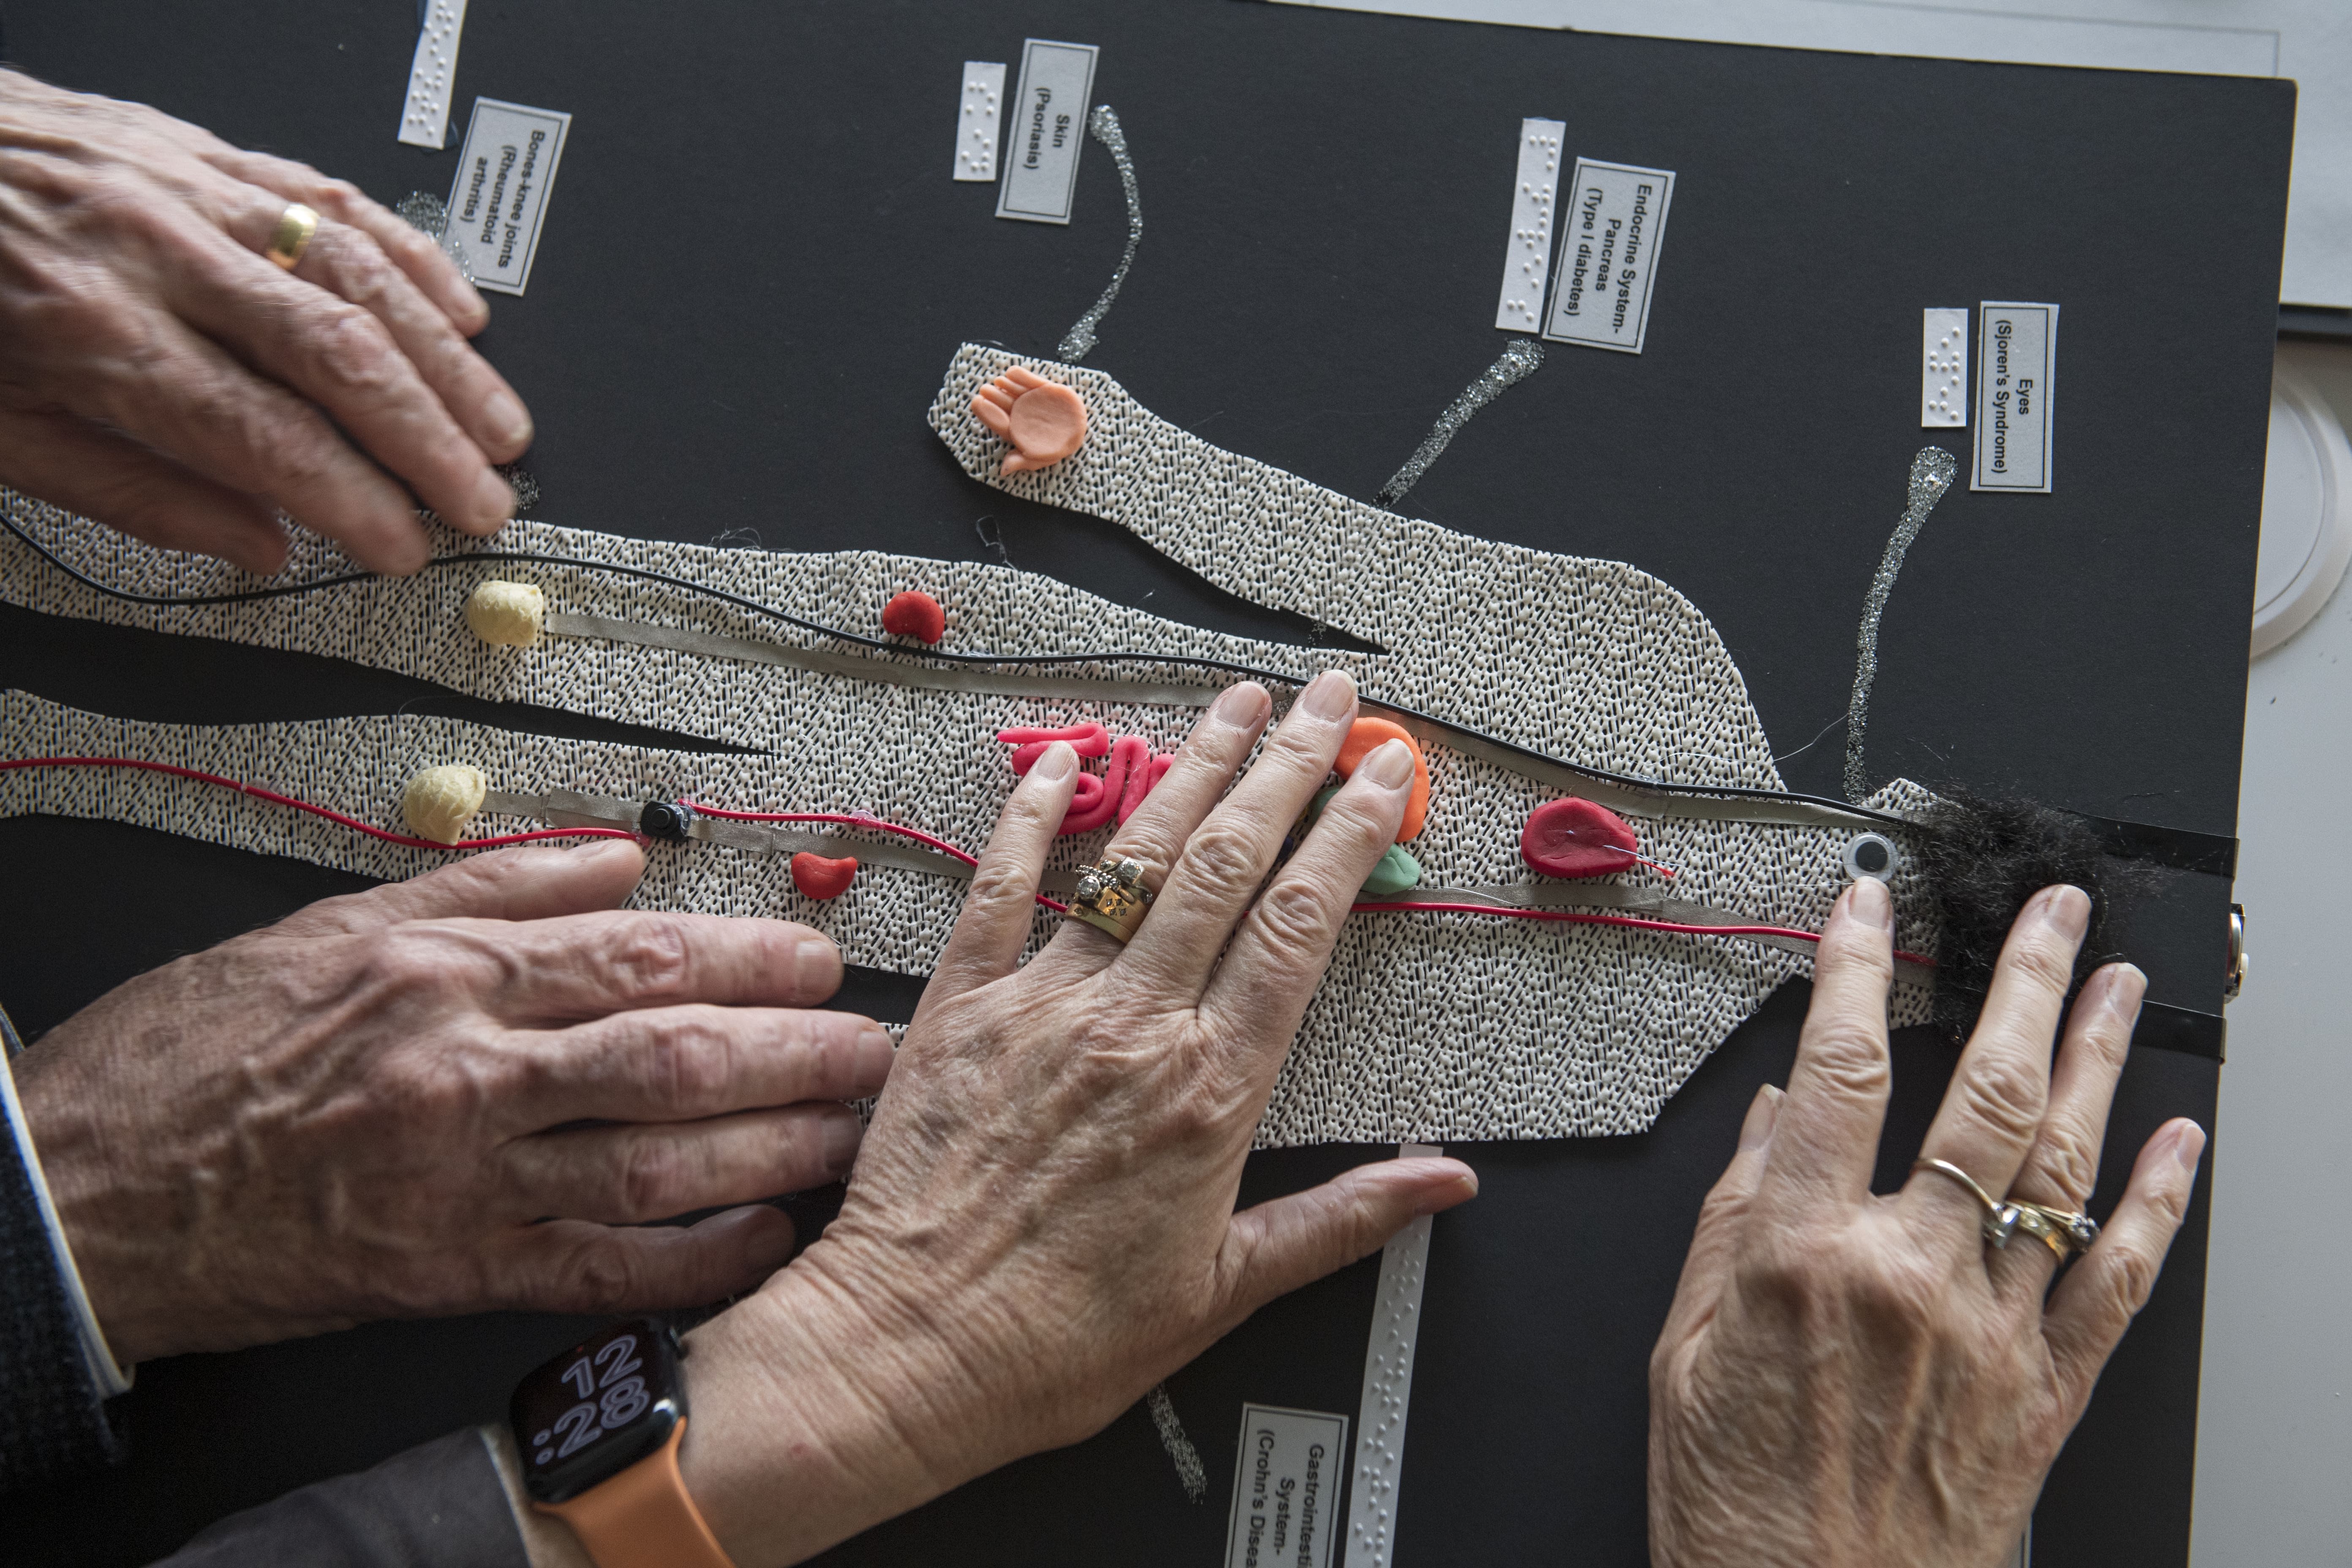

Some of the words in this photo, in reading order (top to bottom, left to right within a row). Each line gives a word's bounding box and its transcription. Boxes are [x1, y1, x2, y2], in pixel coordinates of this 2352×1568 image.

[1024, 88, 1051, 170] (Psoriasis)
[1053, 115, 1070, 147] Skin
[460, 158, 487, 222] arthritis)
[481, 146, 517, 244] (Rheumatoid
[511, 131, 545, 221] Bones-knee
[1583, 188, 1603, 230] (Type
[498, 223, 520, 268] joints
[1595, 219, 1621, 291] Pancreas
[1625, 185, 1652, 264] Endocrine
[1564, 244, 1591, 316] diabetes)
[1613, 270, 1636, 333] System-
[1995, 320, 2012, 386] (Sjoren's
[1991, 391, 2009, 474] Syndrome)
[2016, 379, 2033, 415] Eyes
[561, 1334, 643, 1399] 12
[532, 1375, 651, 1466] :28
[1252, 1429, 1274, 1509] (Crohn's
[1274, 1478, 1295, 1555] System-
[1298, 1444, 1324, 1568] Gastrointesti
